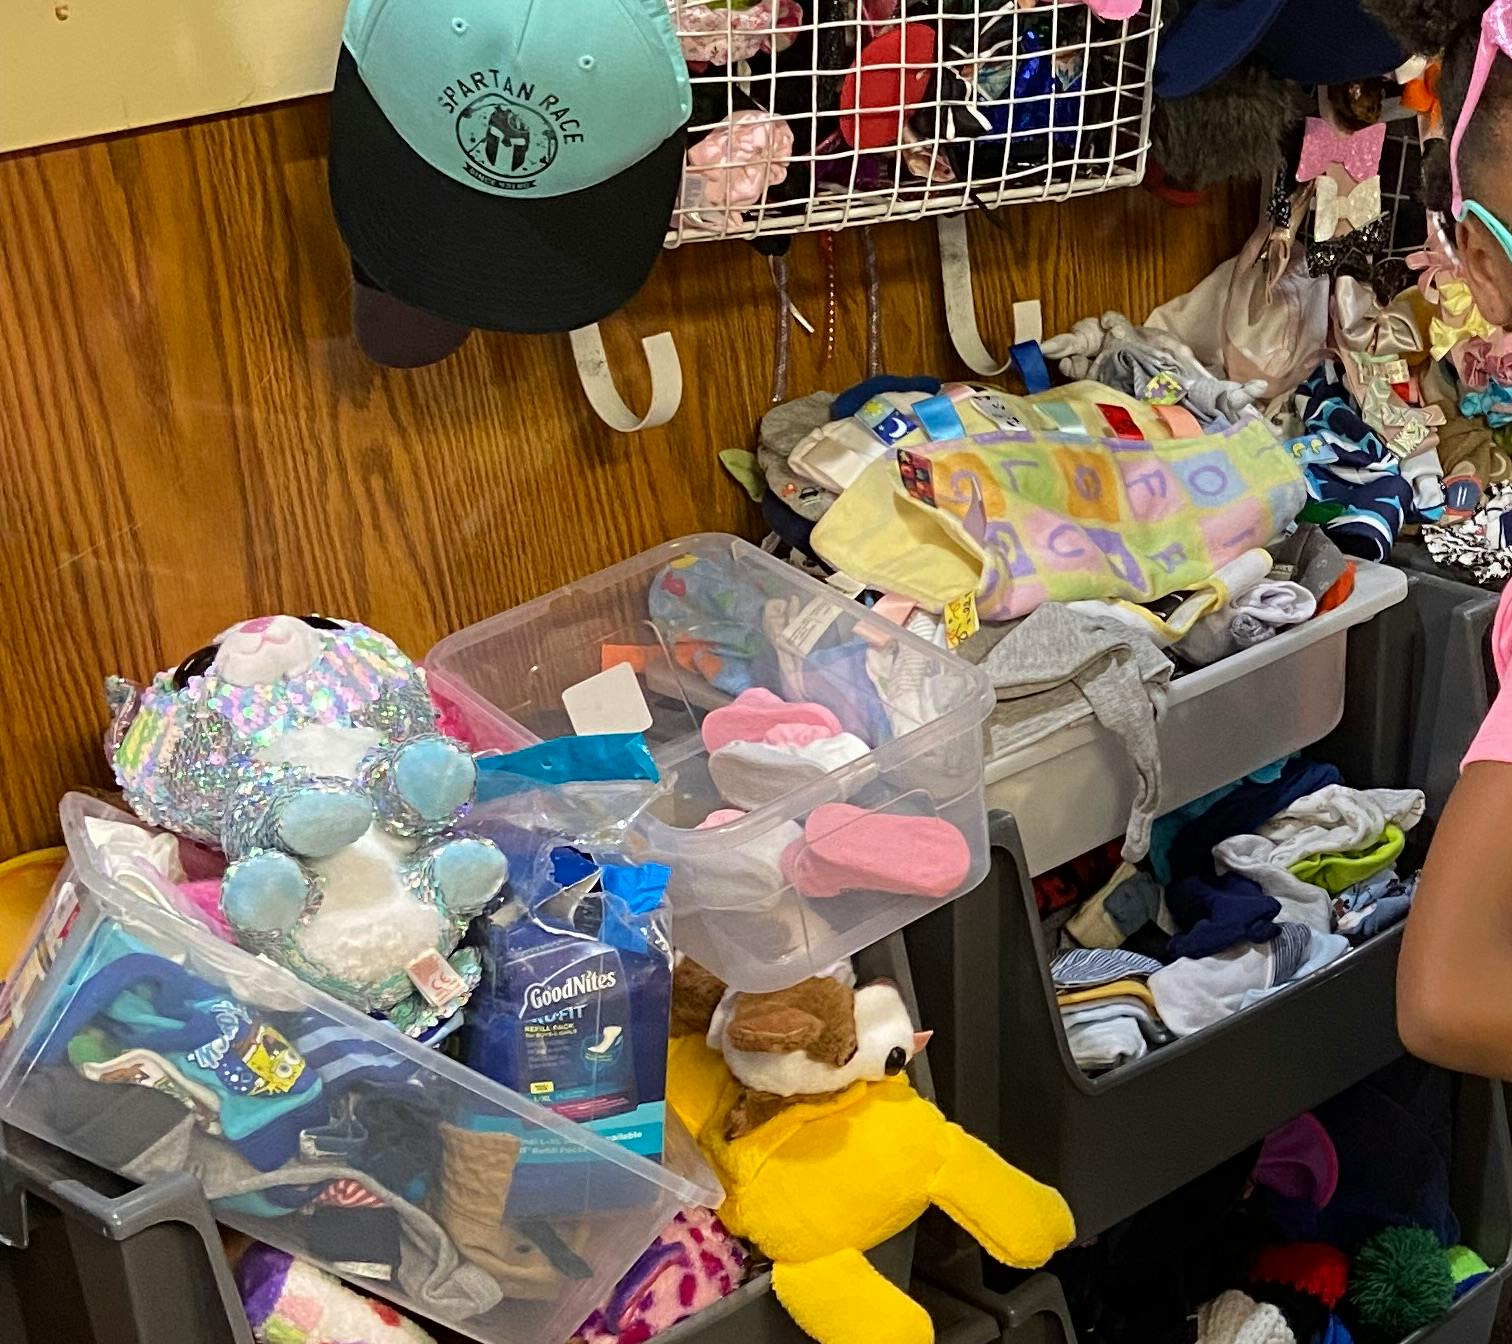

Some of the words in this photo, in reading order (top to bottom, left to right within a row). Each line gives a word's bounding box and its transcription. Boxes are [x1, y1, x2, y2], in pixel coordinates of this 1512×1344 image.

[438, 69, 535, 114] SPARTAN
[539, 93, 584, 145] RACE
[530, 969, 617, 1009] GoodNites
